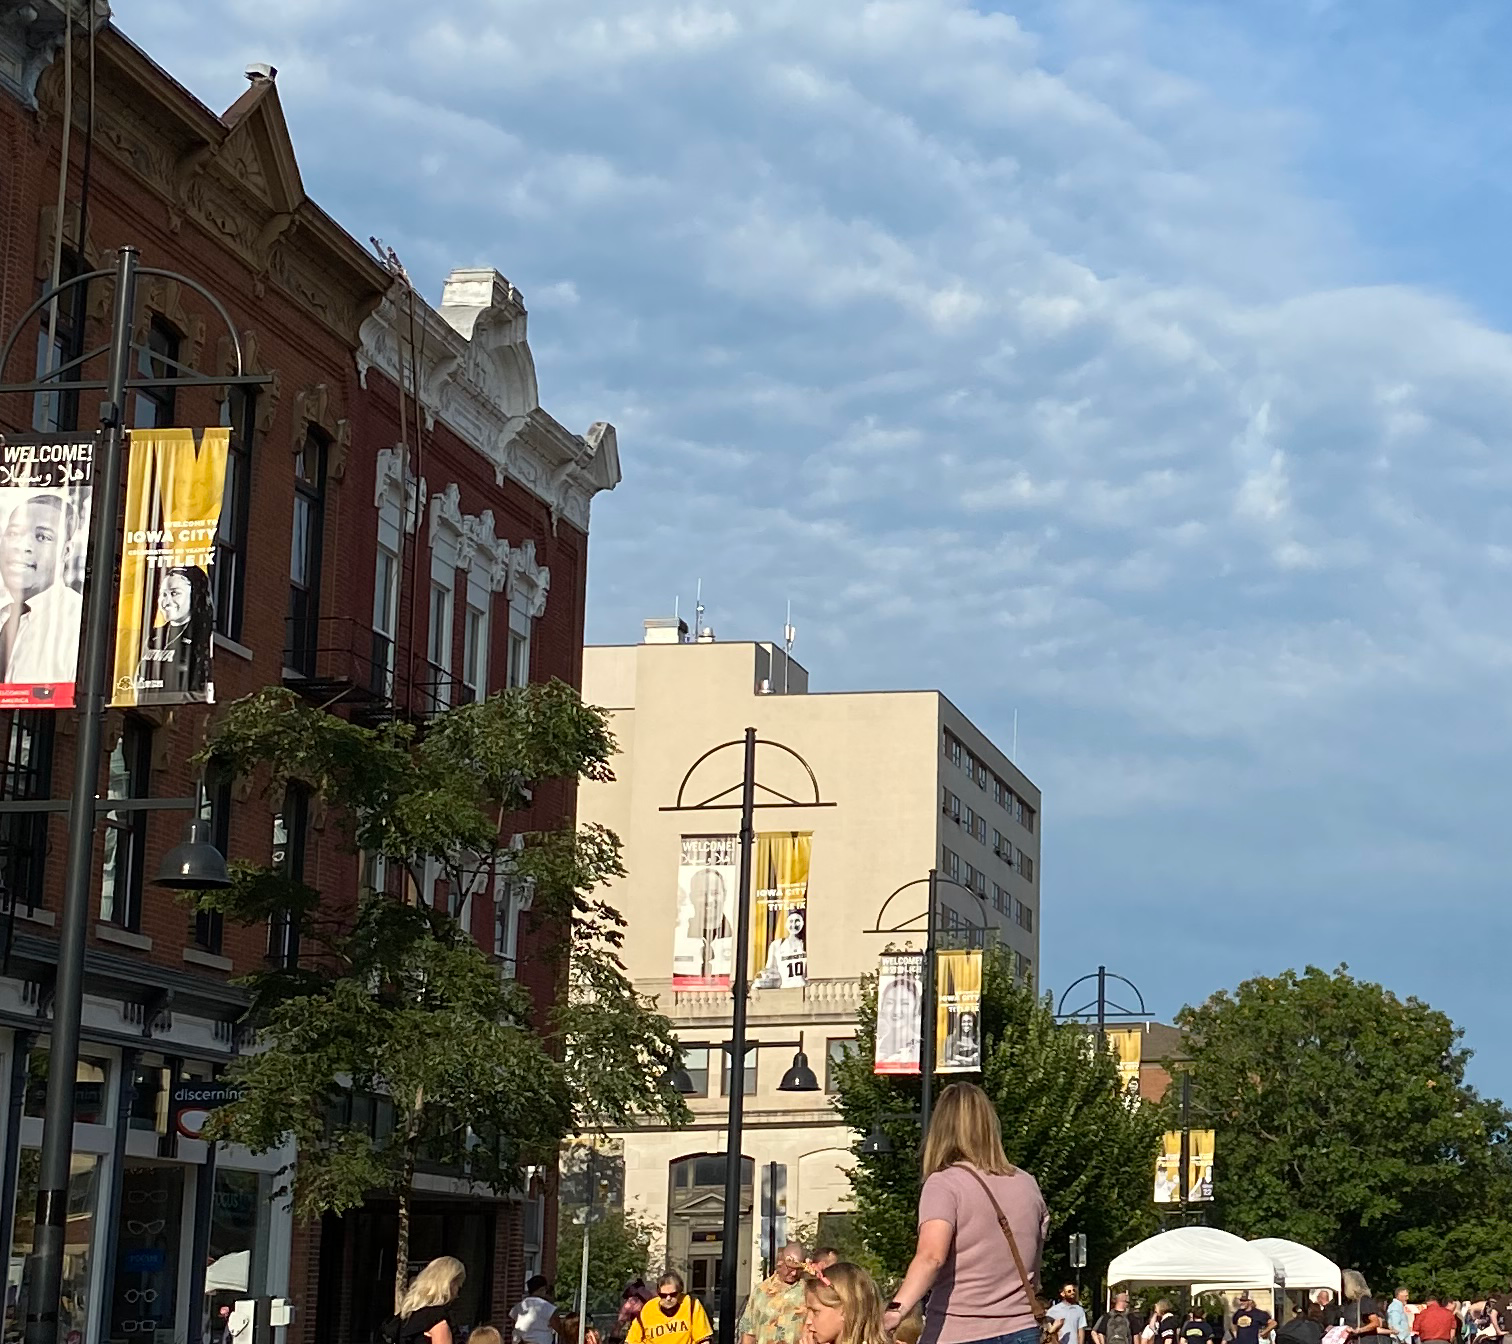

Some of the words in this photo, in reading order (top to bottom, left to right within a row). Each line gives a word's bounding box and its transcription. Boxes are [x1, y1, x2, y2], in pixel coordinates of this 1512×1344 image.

[4, 444, 93, 463] WELCOME!
[127, 530, 174, 543] IOWA
[178, 528, 217, 542] CITY
[146, 555, 195, 568] TITLE
[200, 553, 215, 565] IX
[682, 841, 734, 851] WELCOME!
[757, 889, 783, 897] IOWA
[787, 961, 804, 977] 10
